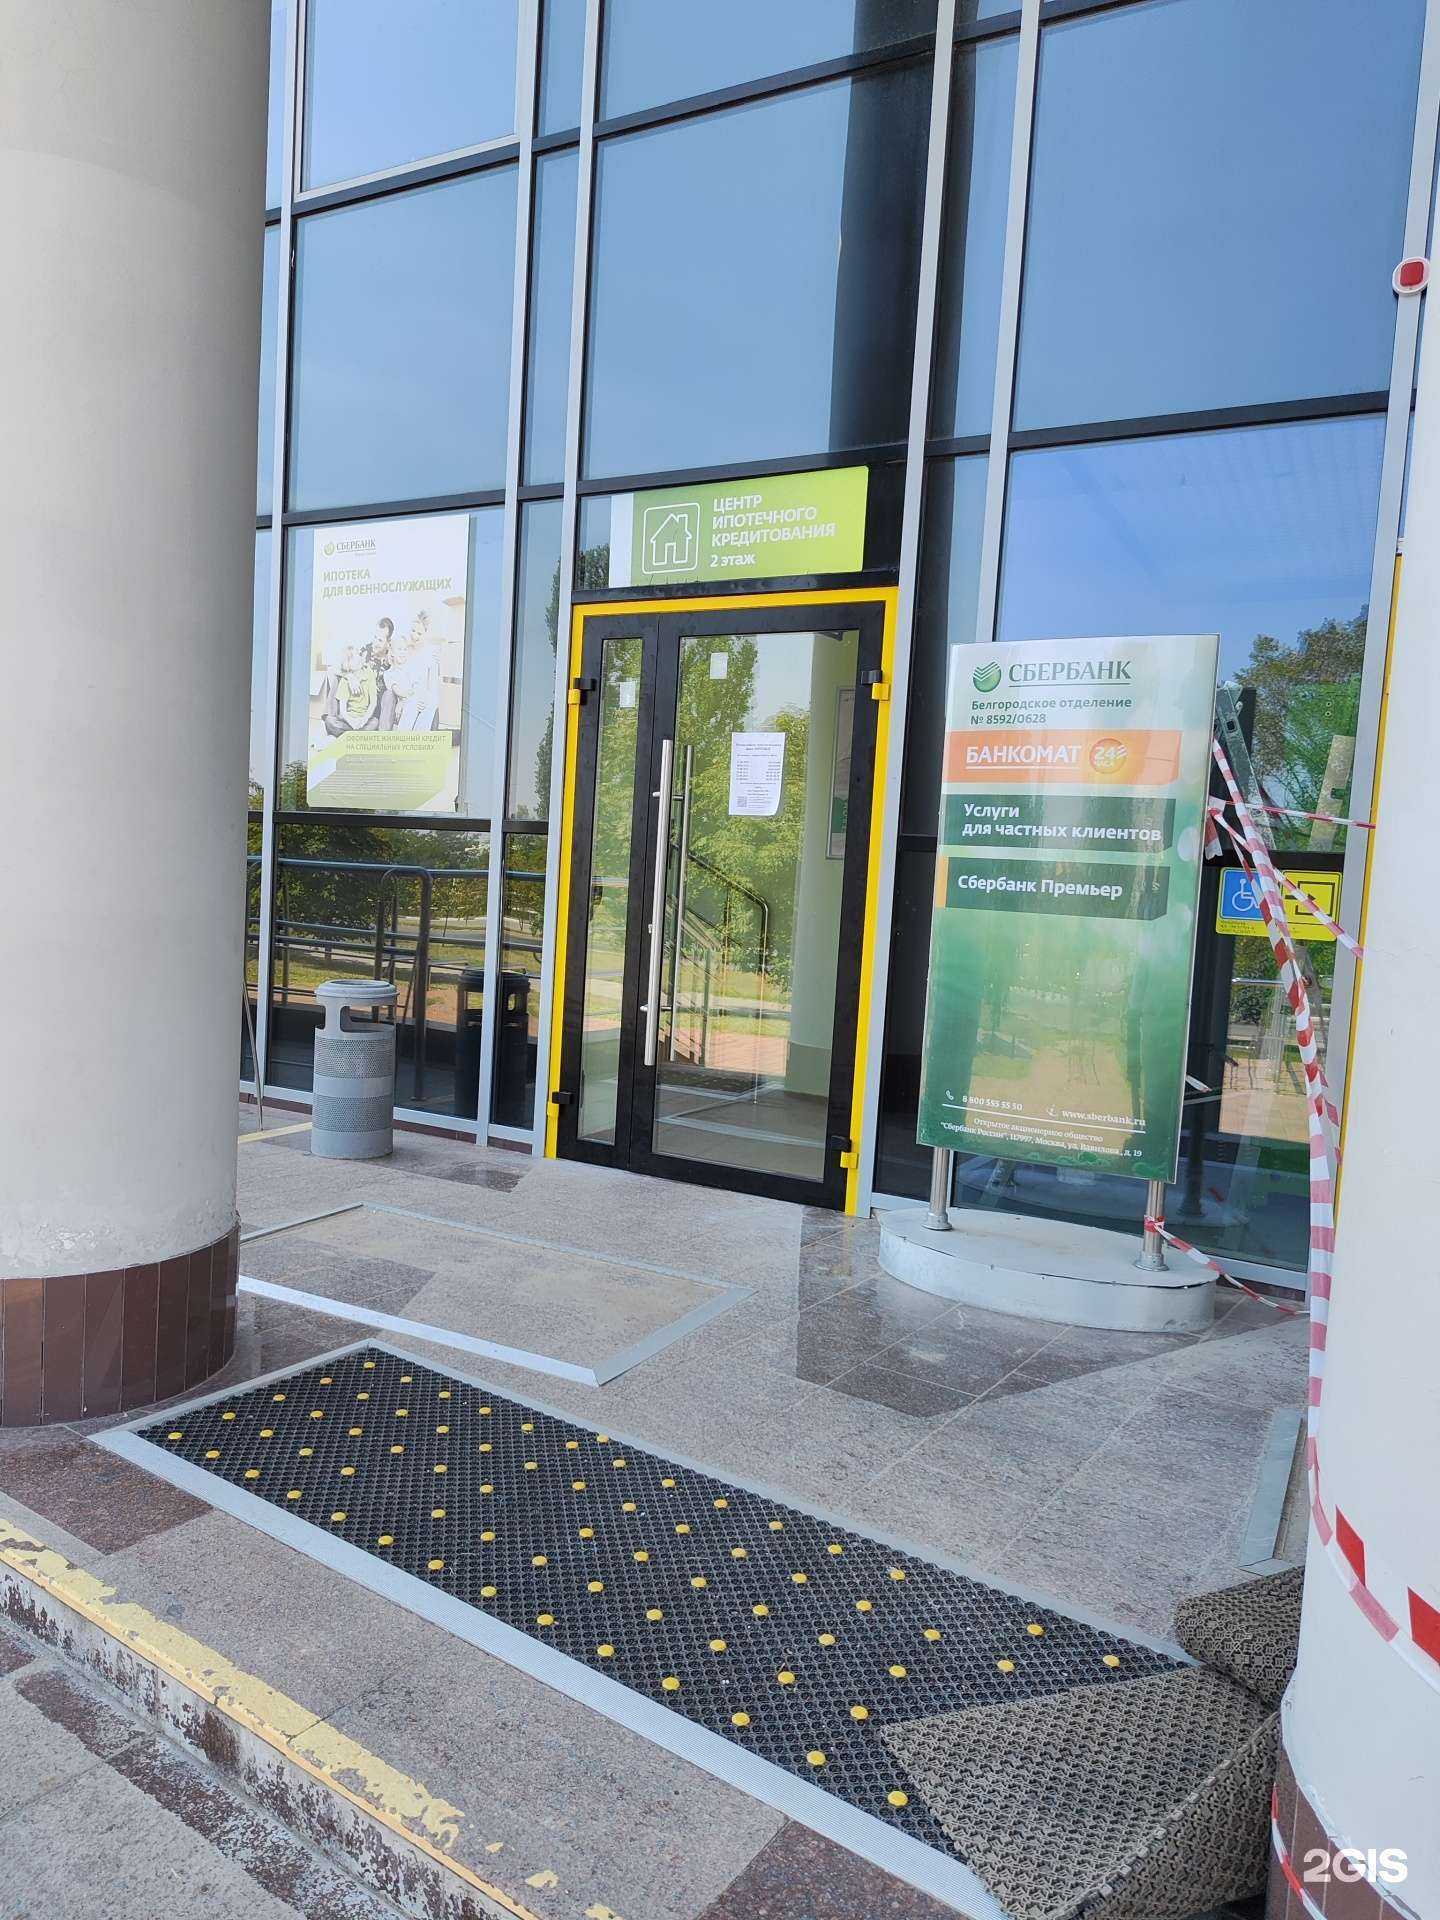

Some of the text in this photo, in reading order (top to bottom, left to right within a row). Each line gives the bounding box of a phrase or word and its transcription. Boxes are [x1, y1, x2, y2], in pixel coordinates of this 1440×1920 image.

[713, 495, 762, 514] ЦЕНТР
[712, 506, 817, 529] ИПОТЕЧНОГО
[711, 522, 836, 547] КРЕДИТОВАНИЯ
[710, 554, 756, 567] 2 этаж
[323, 568, 370, 582] ИПОТЕКА
[323, 577, 452, 599] ДЛЯ ВОЕННОСЛУЖАЩИХ
[1009, 660, 1132, 682] СБЕРБАНК
[972, 698, 1132, 713] Белгородское отделение
[971, 713, 1046, 725] № 8592/0628
[966, 745, 1082, 764] БАНКОМАТ
[963, 803, 1020, 820] Услуги
[962, 823, 1162, 841] для частных клиентов
[958, 875, 1123, 900] Сбербанк Премьер
[1061, 1110, 1146, 1126] www.sberbank.ru
